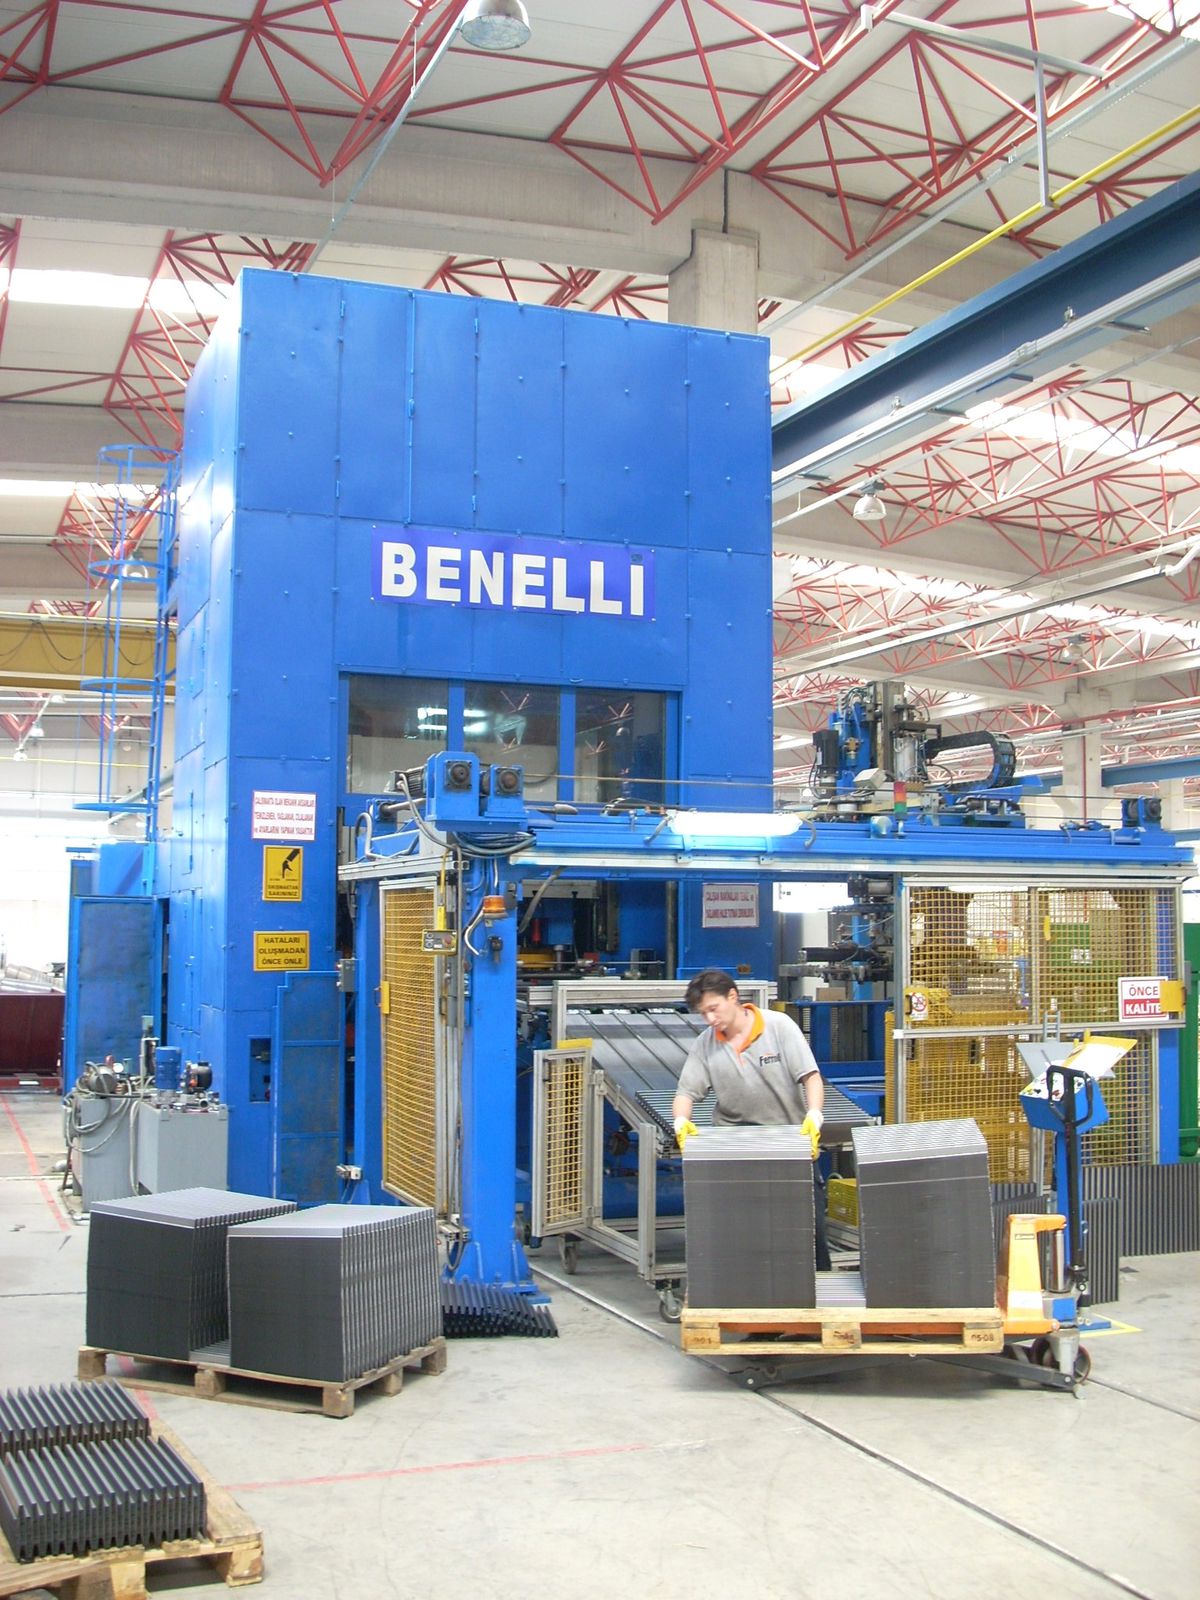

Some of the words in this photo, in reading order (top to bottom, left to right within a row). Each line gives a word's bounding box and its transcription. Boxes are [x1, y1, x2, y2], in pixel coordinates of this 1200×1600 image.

[381, 541, 644, 616] BENELLI
[264, 936, 300, 944] HATALARI
[1129, 984, 1159, 997] ÖNCE
[1126, 1000, 1161, 1015] KALİTE
